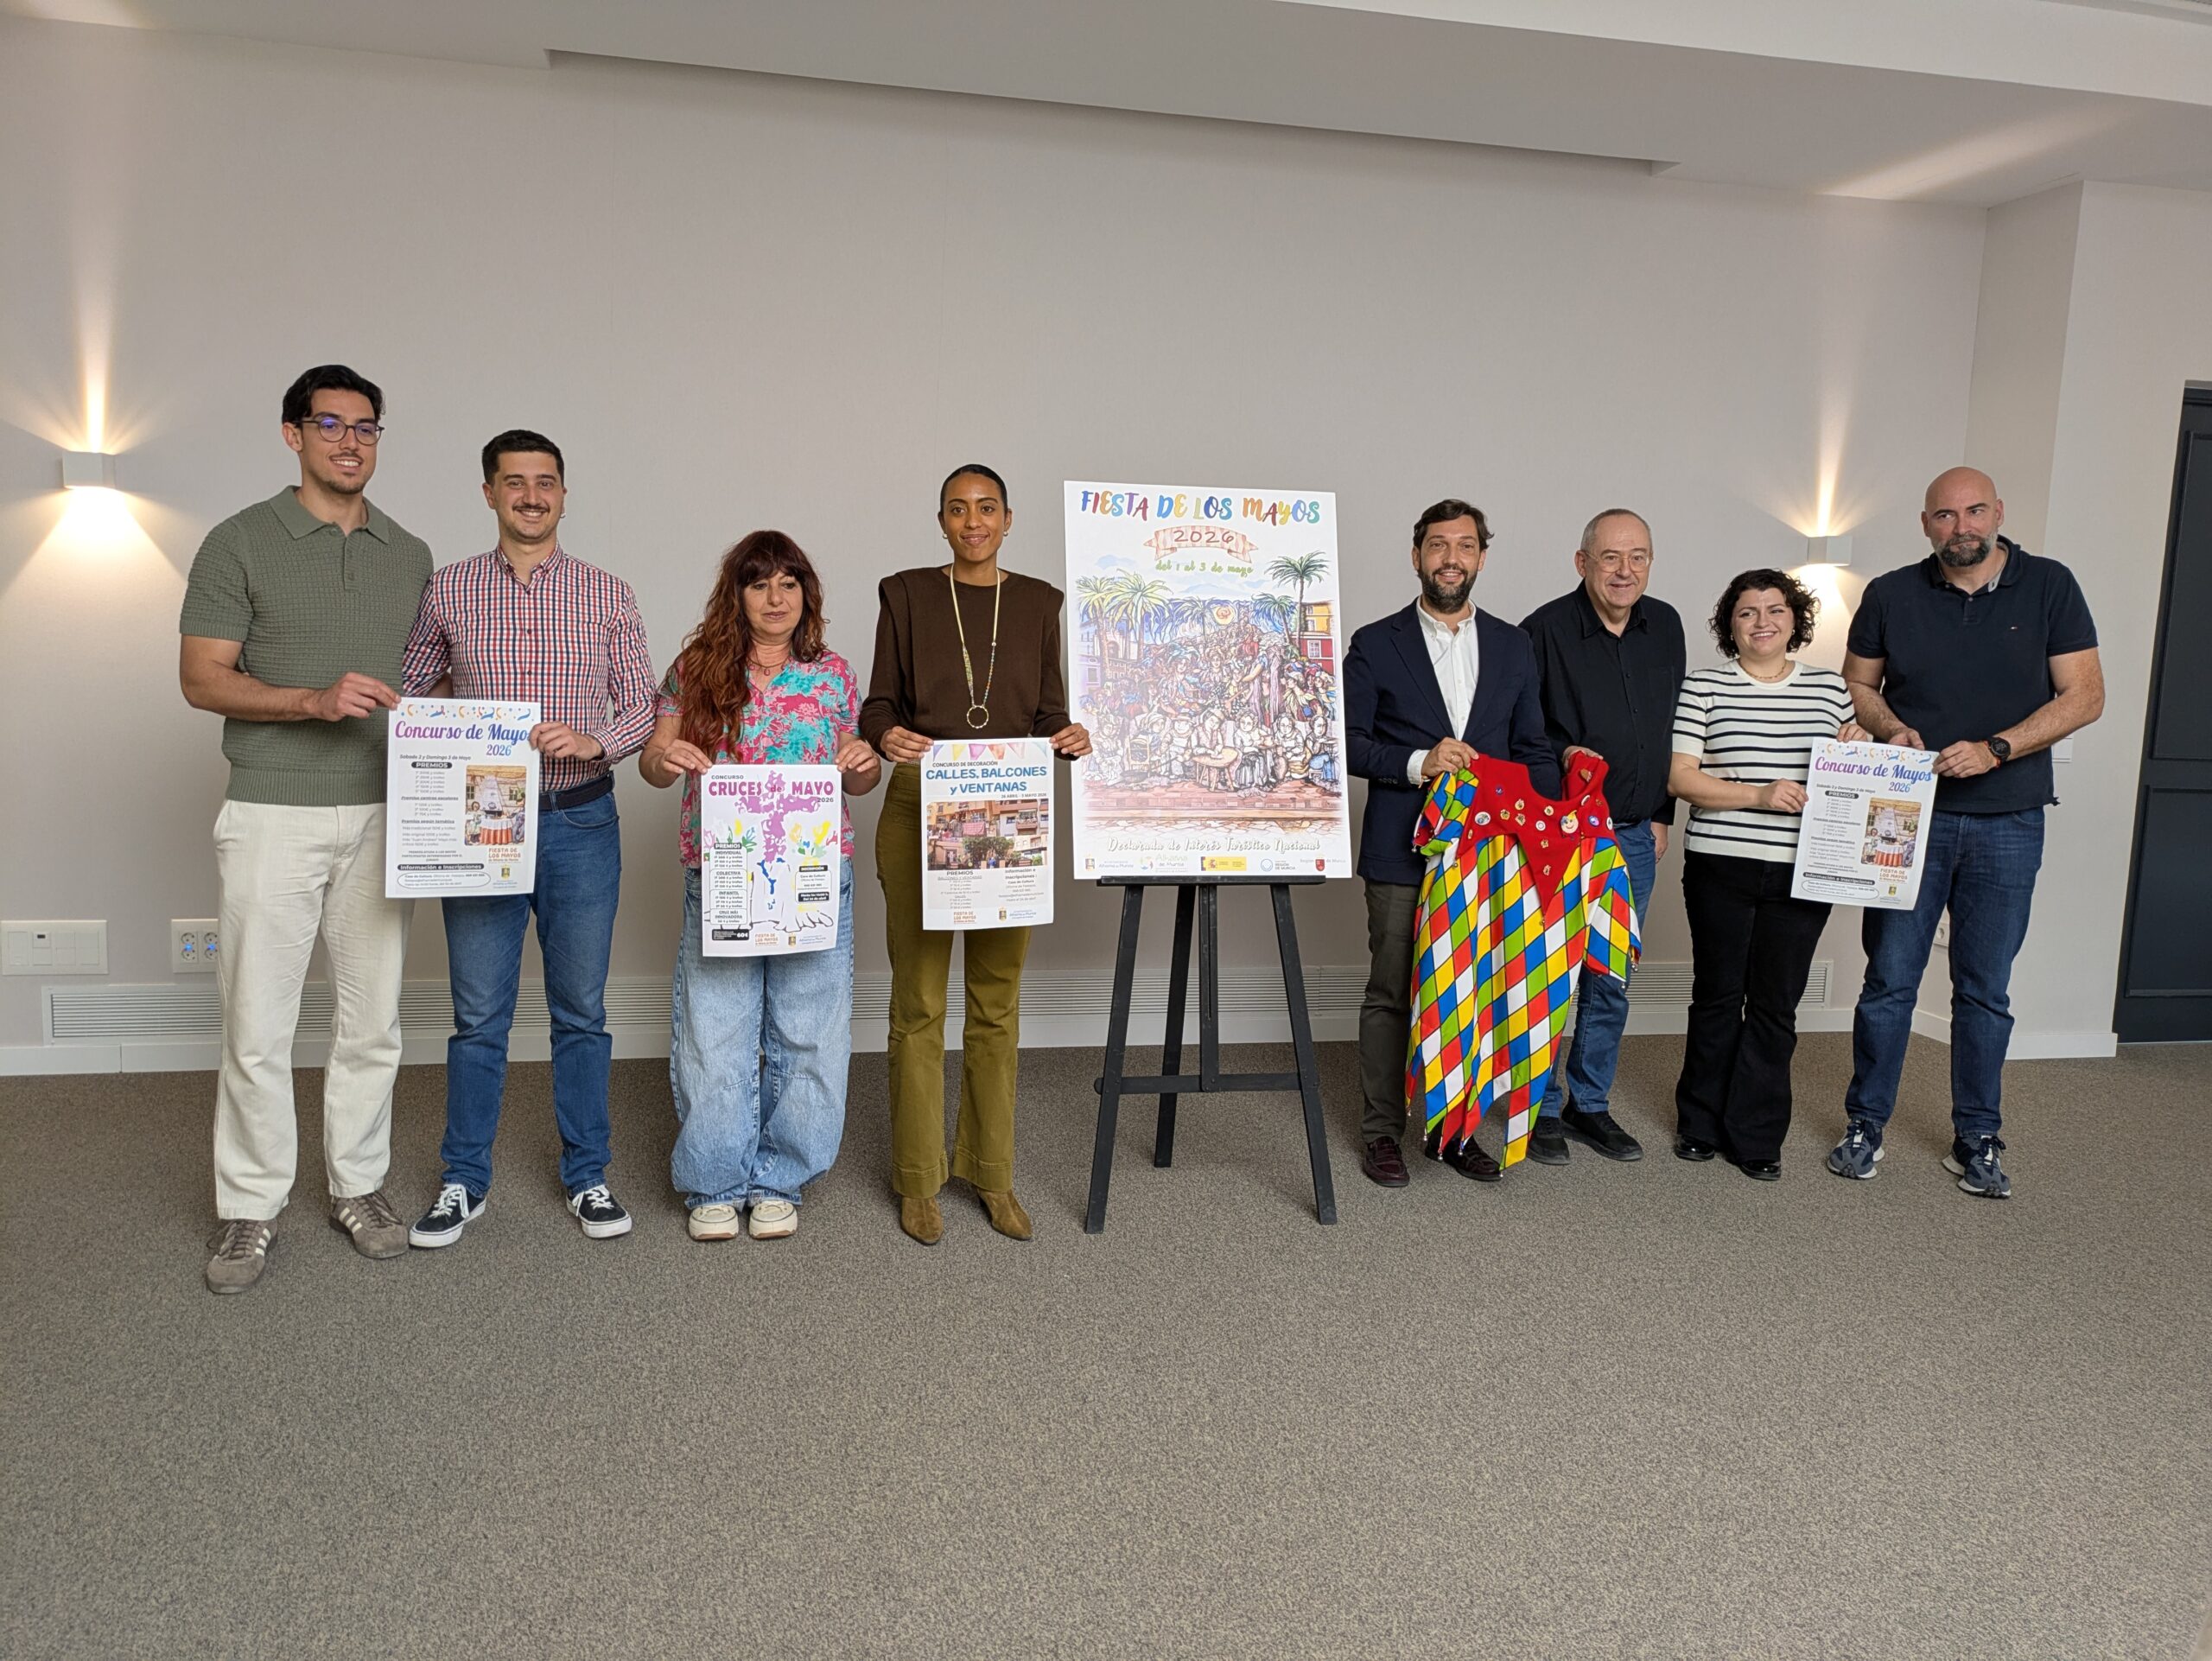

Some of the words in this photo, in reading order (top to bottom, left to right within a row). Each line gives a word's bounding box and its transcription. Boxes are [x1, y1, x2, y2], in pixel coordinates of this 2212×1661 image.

[1082, 490, 1148, 521] FIESTA
[1157, 493, 1187, 519] DE
[1193, 495, 1233, 520] LOS
[1243, 497, 1319, 525] MAYOS
[1173, 530, 1234, 544] 2026
[1155, 559, 1172, 571] del
[1176, 563, 1179, 571] 1
[1184, 560, 1196, 571] al
[1199, 562, 1206, 571] 3
[1211, 562, 1224, 573] de
[1228, 566, 1254, 578] mayo
[395, 720, 463, 739] Concurso
[466, 723, 483, 740] de
[488, 723, 529, 746] Mayo
[486, 744, 512, 756] 2026
[982, 767, 1046, 778] BALCONES
[1815, 756, 1871, 774] Concurso
[1873, 764, 1888, 777] de
[1892, 765, 1932, 785] Mayos
[709, 781, 762, 796] CRUCES
[792, 781, 834, 795] MAYO
[950, 786, 957, 795] y
[960, 781, 1027, 793] VENTANAS
[1889, 782, 1910, 792] 2026
[1108, 837, 1164, 851] Declarada
[1167, 839, 1181, 850] de
[1185, 837, 1221, 851] Interés
[1226, 837, 1271, 851] Turístico
[1274, 837, 1320, 854] Nacional
